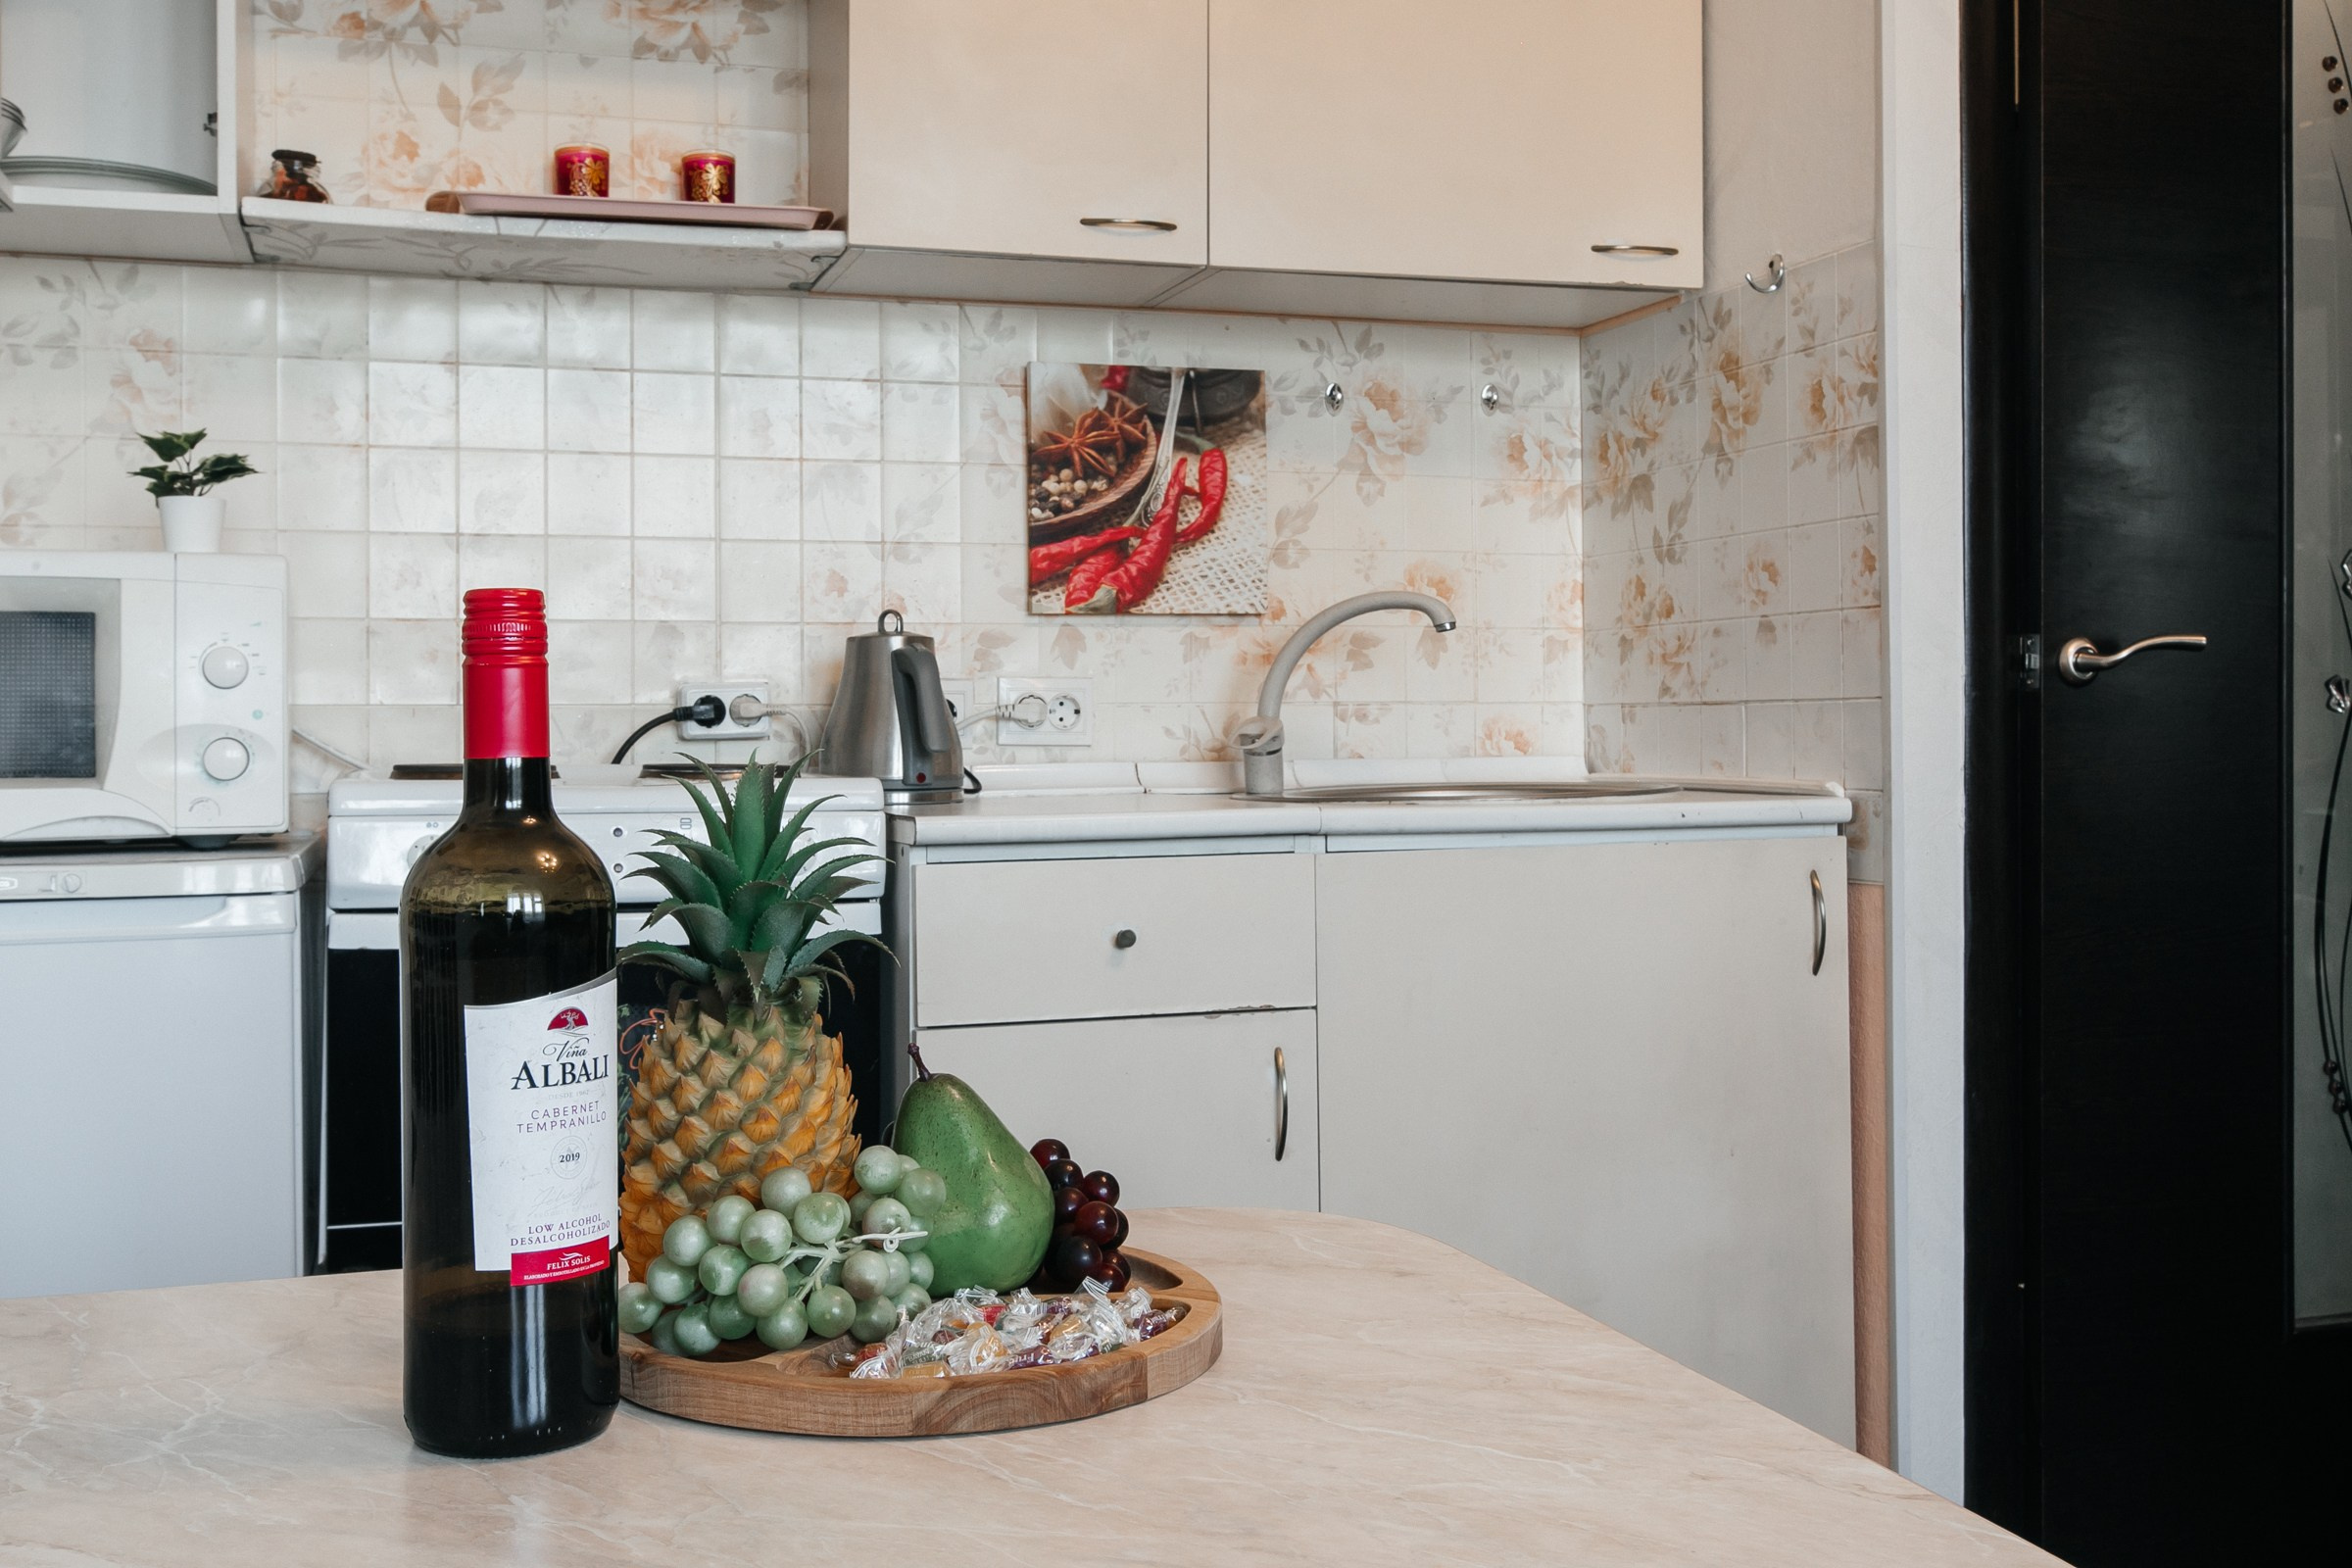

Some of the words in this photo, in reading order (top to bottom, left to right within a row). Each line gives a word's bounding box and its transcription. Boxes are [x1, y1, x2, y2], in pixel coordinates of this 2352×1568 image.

[542, 1037, 590, 1062] Viña
[510, 1054, 610, 1091] ALBALI
[516, 1110, 607, 1134] TEMPRANILLO
[530, 1101, 601, 1120] CABERNET
[559, 1152, 581, 1163] 2019
[510, 1220, 611, 1247] DESALCOHOLIZADO
[528, 1223, 554, 1235] LOW
[558, 1213, 603, 1231] ALCOHOL
[547, 1260, 570, 1271] FELIX
[571, 1255, 591, 1267] SOLIS
